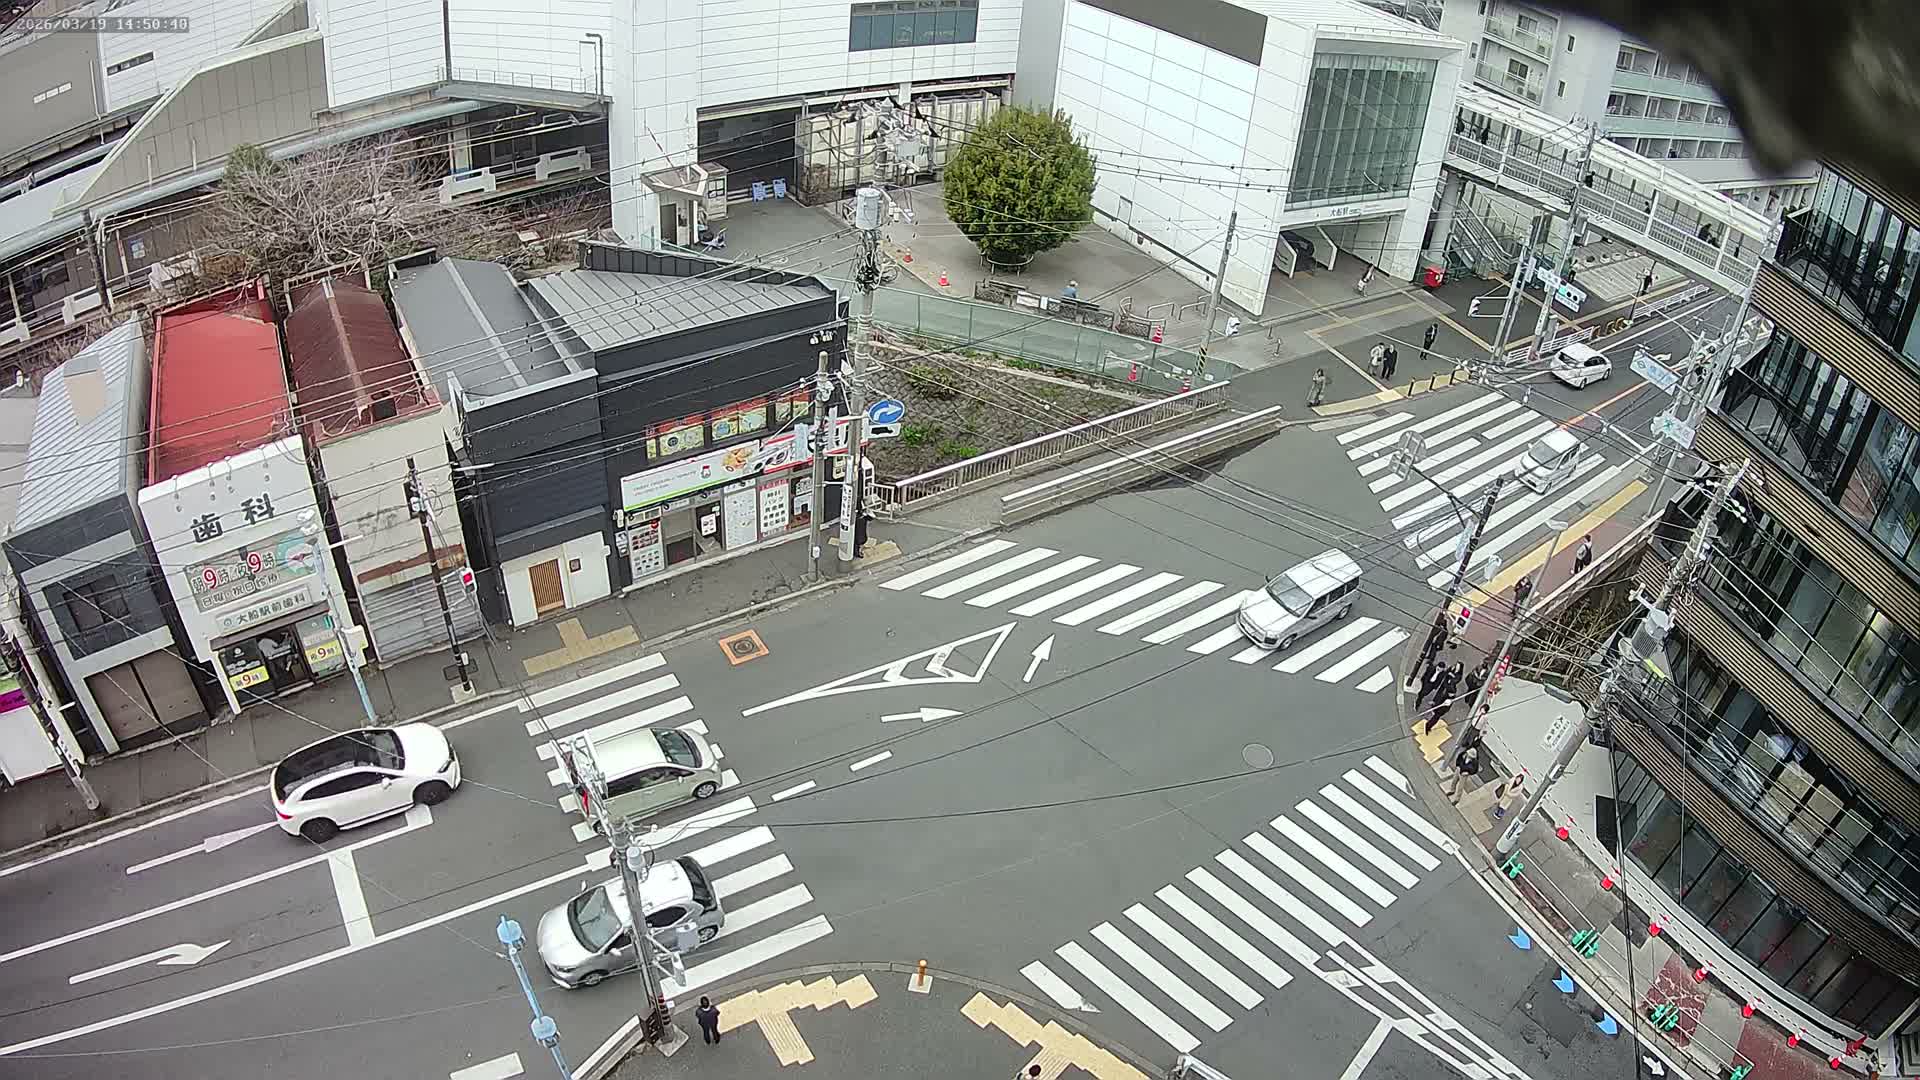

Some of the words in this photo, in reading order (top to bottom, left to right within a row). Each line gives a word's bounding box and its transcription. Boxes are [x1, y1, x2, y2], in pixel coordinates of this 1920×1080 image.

[190, 494, 275, 543] 歯科
[237, 593, 305, 625] 大船駅前歯科
